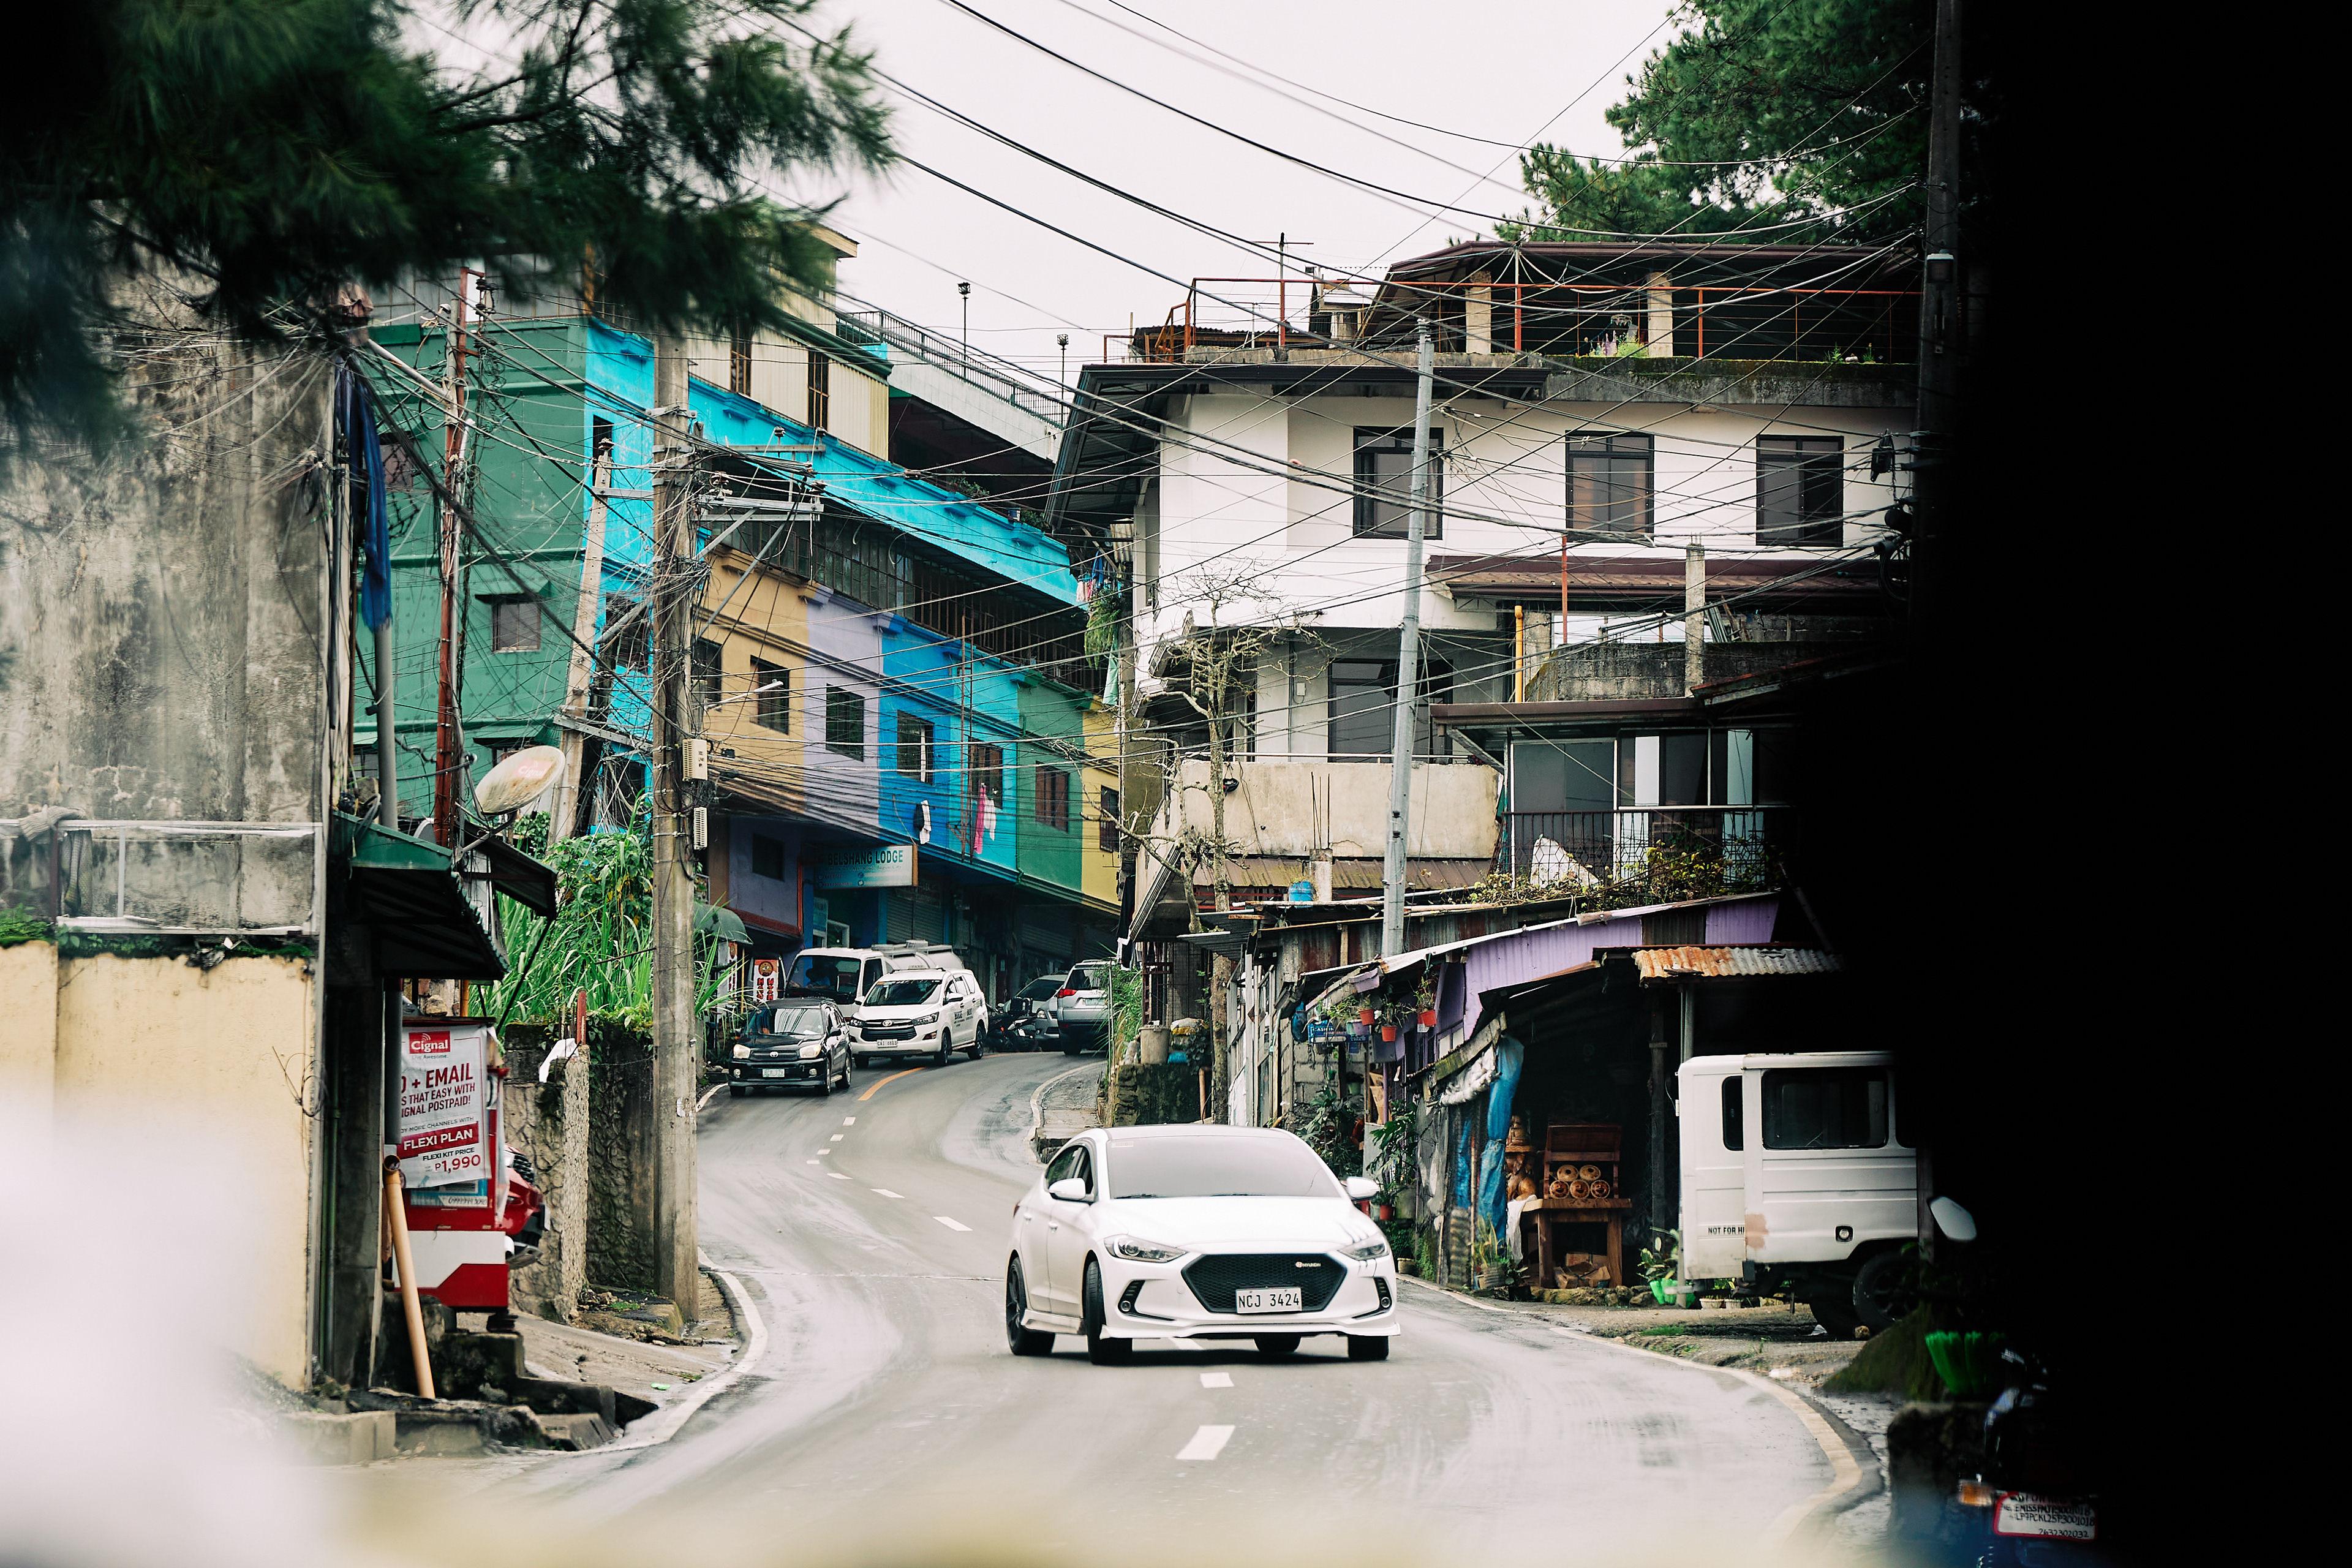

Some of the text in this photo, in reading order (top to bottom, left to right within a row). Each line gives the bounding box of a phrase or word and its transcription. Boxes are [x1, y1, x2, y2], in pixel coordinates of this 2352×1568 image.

[828, 851, 873, 865] BELSHANG
[876, 850, 903, 864] LODGE
[411, 1039, 448, 1052] Cignal
[426, 1063, 473, 1088] EMAIL
[401, 1082, 475, 1106] S THAT EASY WITH
[401, 1095, 471, 1118] IGNAL POSTPAID!
[427, 1118, 458, 1129] CHANNELS
[404, 1128, 473, 1150] FLEXI PLAN
[423, 1153, 441, 1161] FLEXI
[1238, 1294, 1299, 1308] NCJ 3424
